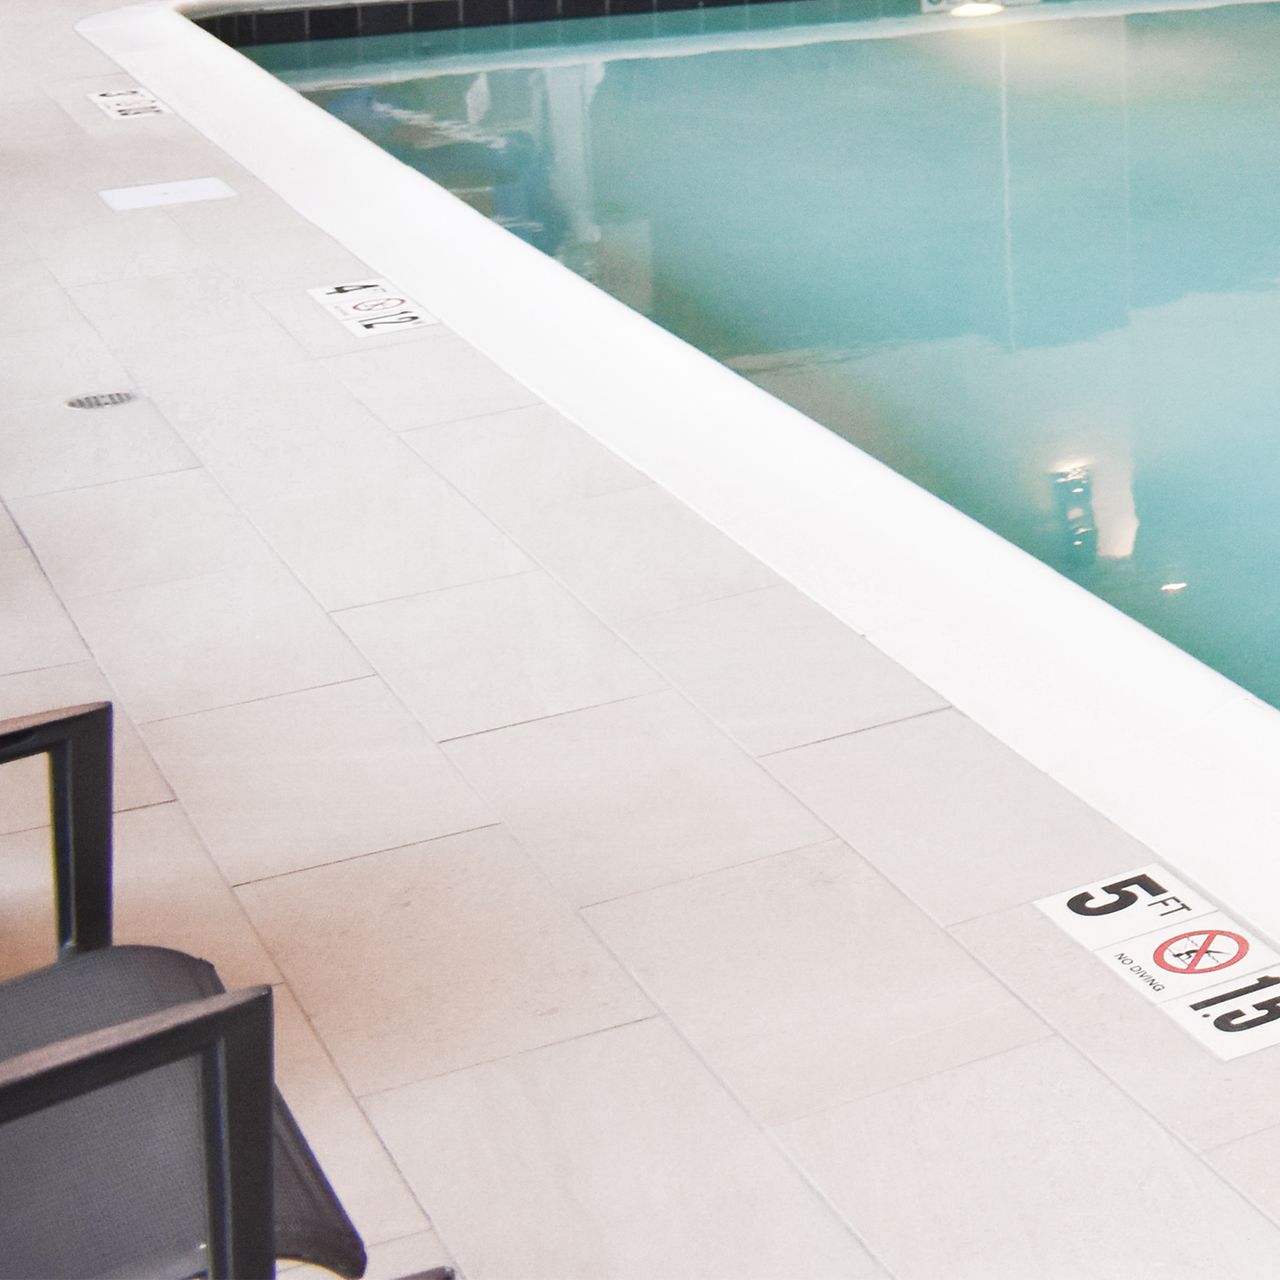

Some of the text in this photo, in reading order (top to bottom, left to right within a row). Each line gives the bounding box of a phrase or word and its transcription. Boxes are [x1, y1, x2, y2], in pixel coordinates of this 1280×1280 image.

[1065, 873, 1193, 917] 5 FT
[1113, 952, 1166, 993] NO DIVING
